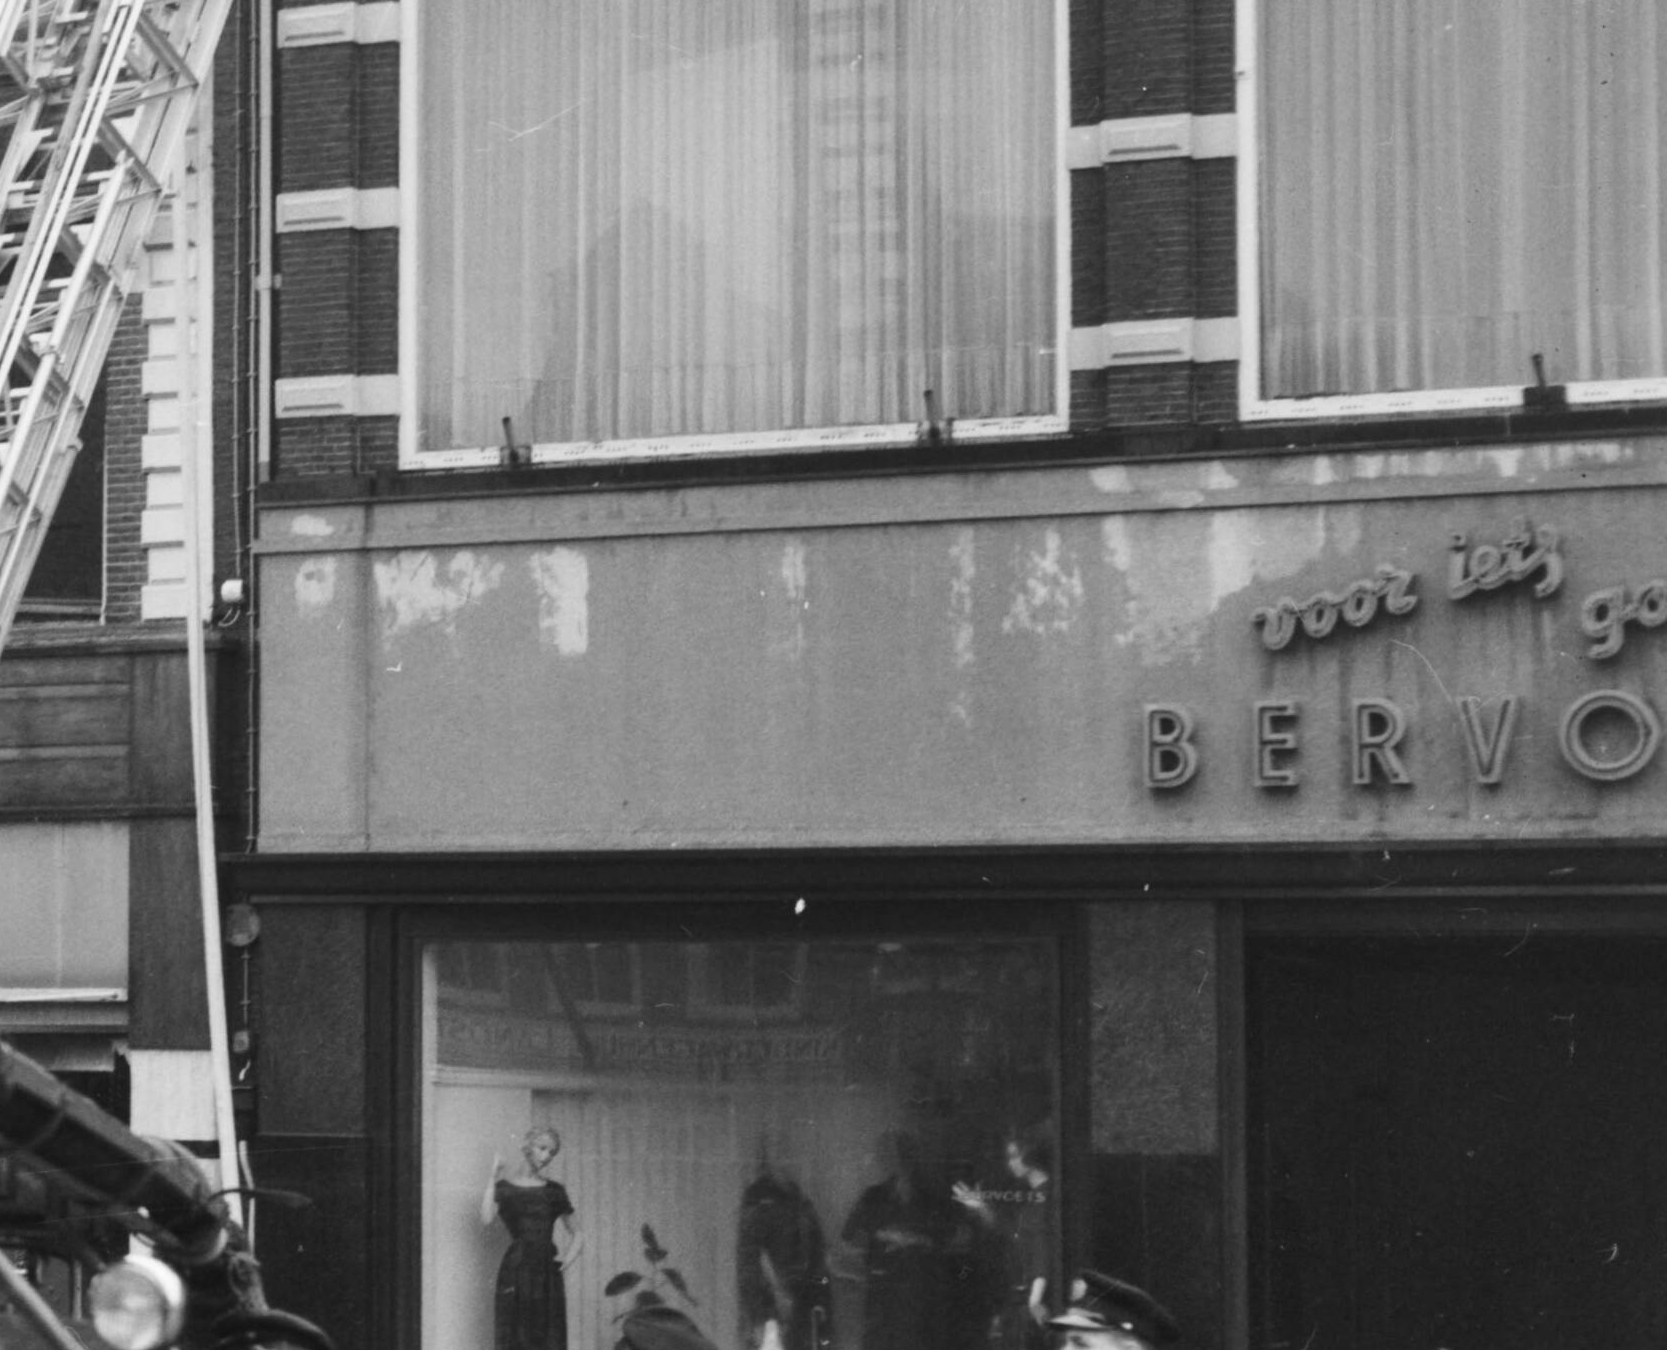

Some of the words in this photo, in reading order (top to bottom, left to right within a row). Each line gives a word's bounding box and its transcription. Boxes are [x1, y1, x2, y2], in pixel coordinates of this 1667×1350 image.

[1252, 563, 1419, 651] voor
[1448, 519, 1564, 601] iets
[1142, 689, 1662, 791] BERVO
